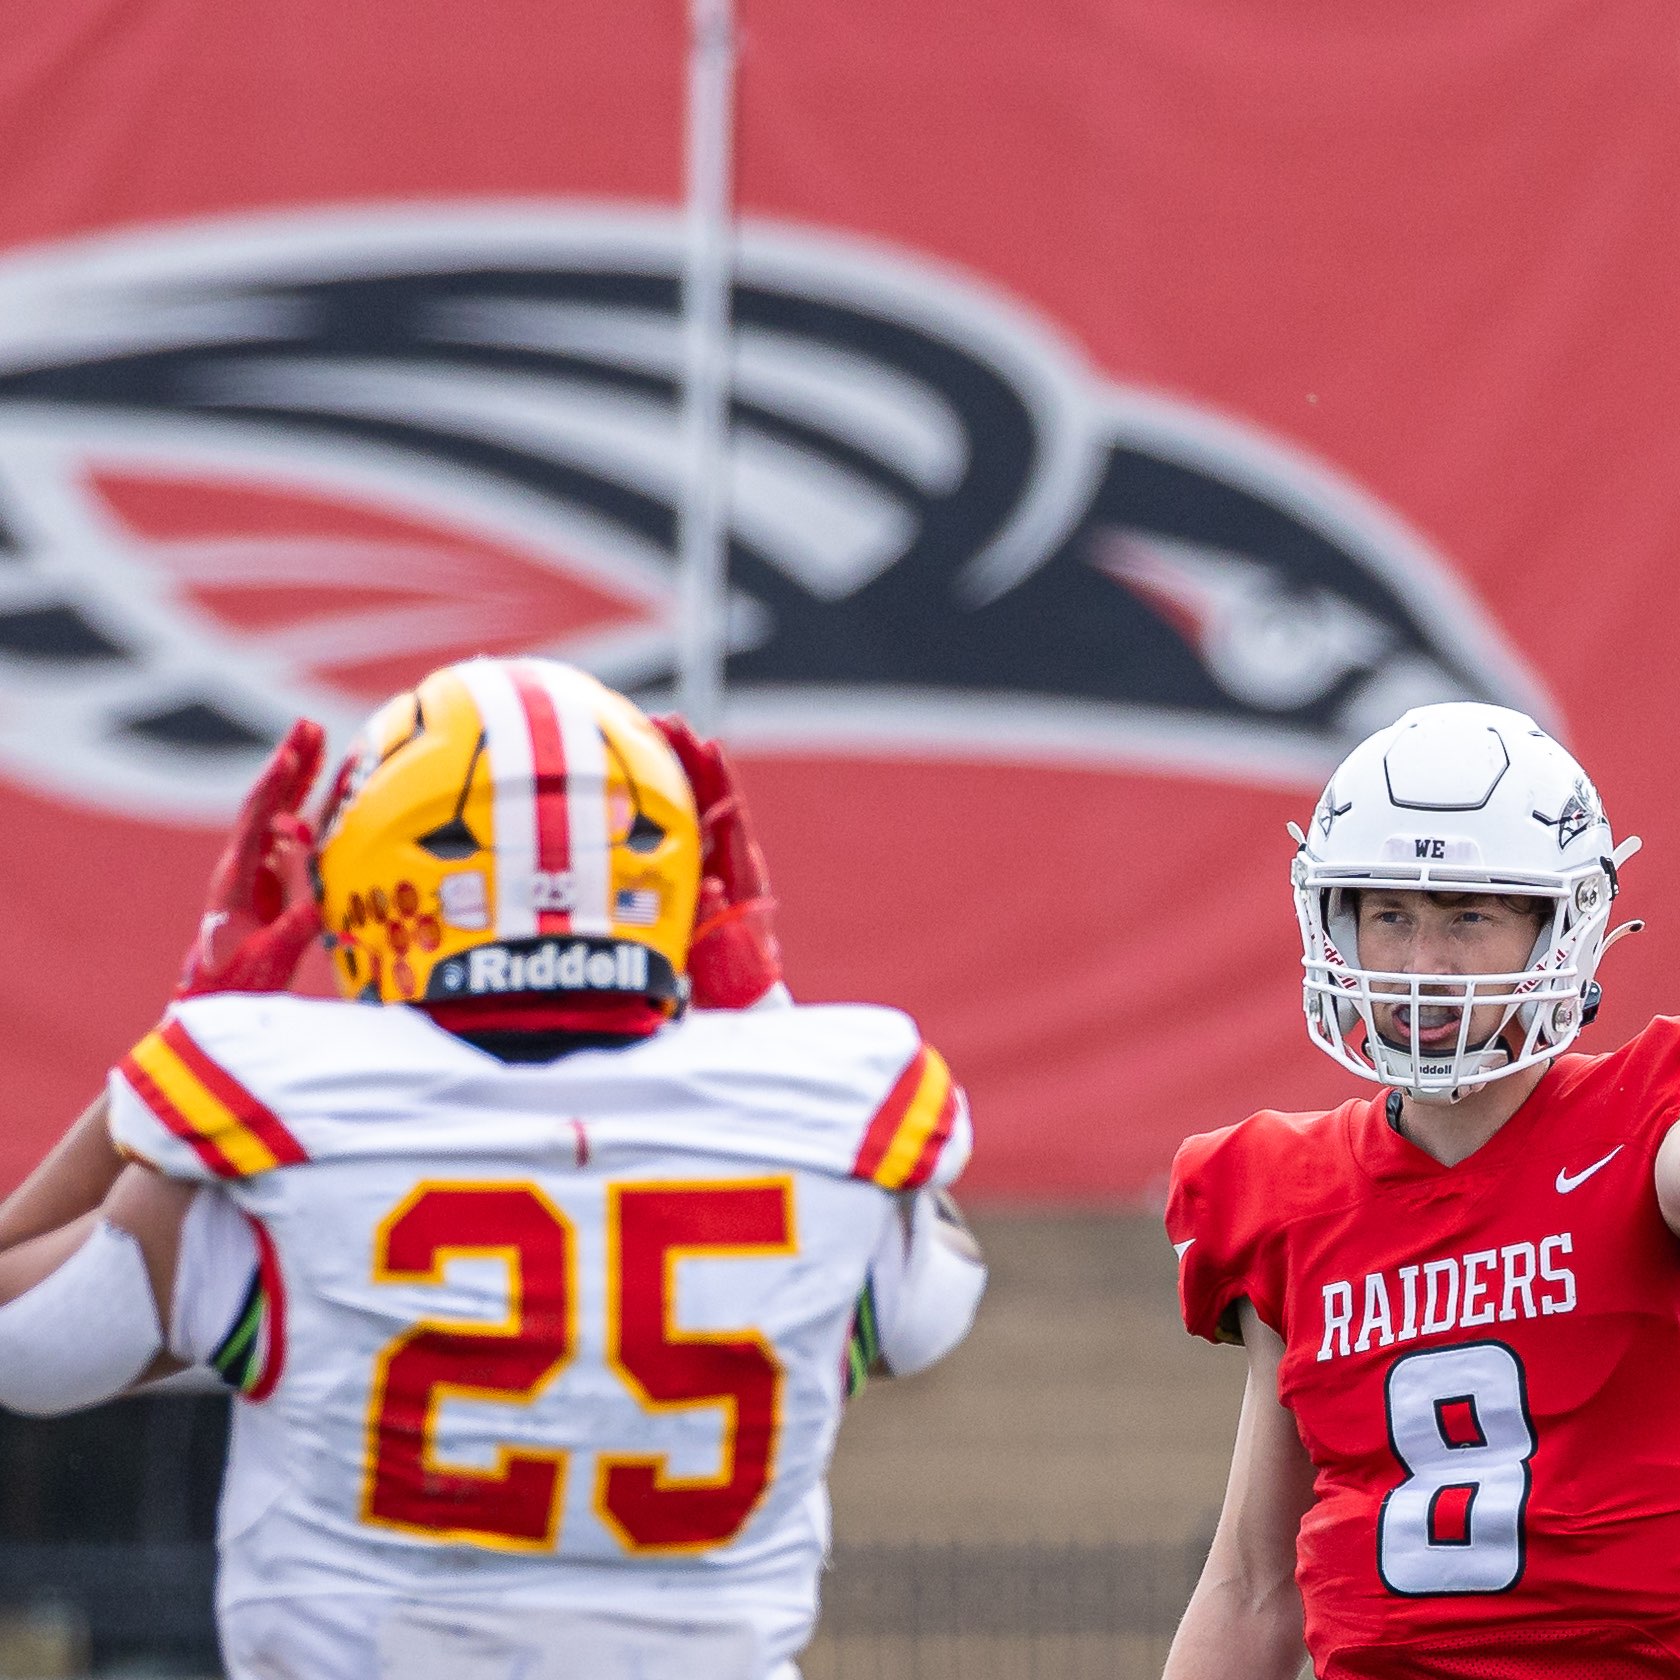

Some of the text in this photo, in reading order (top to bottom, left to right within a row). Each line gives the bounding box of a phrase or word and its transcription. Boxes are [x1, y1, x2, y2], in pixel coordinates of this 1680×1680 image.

[1415, 839, 1446, 859] WE
[1410, 1063, 1452, 1075] iddell
[1317, 1232, 1577, 1361] RAIDERS
[360, 1171, 800, 1557] 25
[1376, 1338, 1539, 1598] 8
